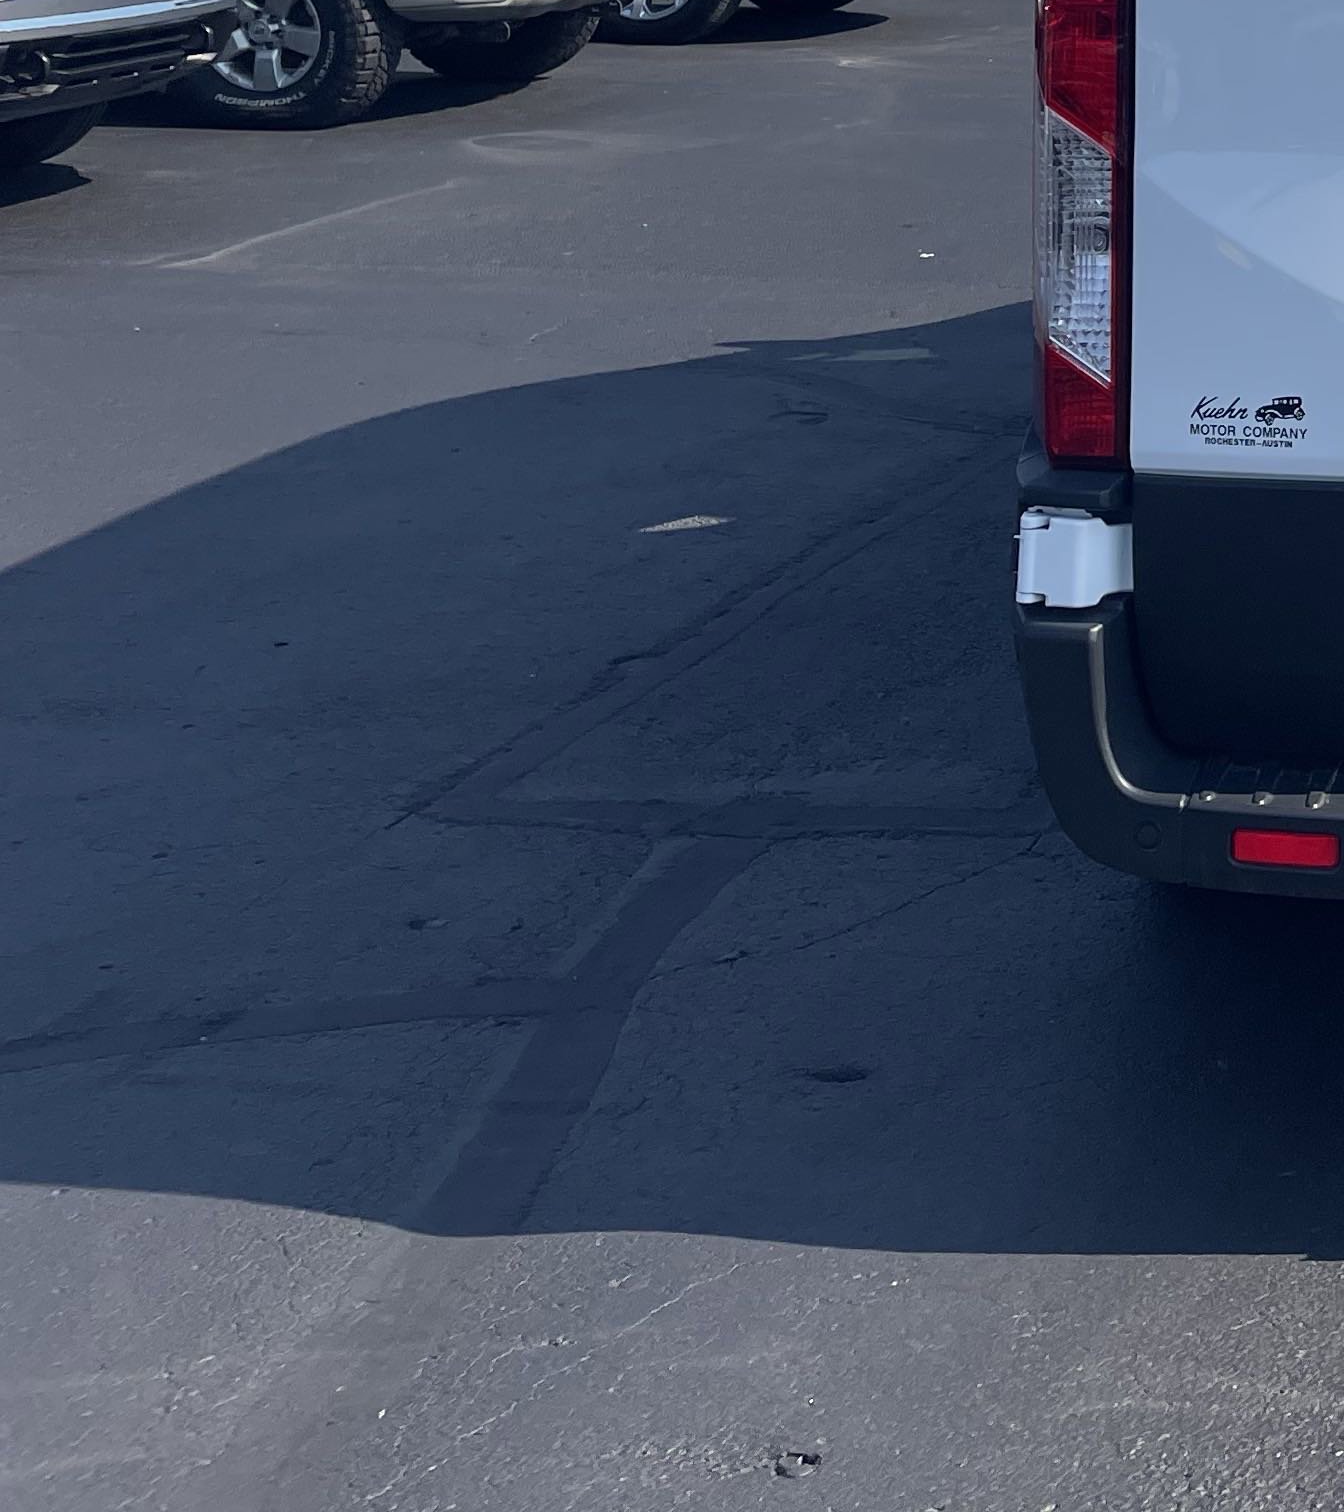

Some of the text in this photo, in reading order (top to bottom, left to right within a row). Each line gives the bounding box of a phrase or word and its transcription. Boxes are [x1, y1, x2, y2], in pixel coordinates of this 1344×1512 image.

[1190, 396, 1249, 421] Kuehn
[1189, 424, 1308, 439] MOTOR COMPANY
